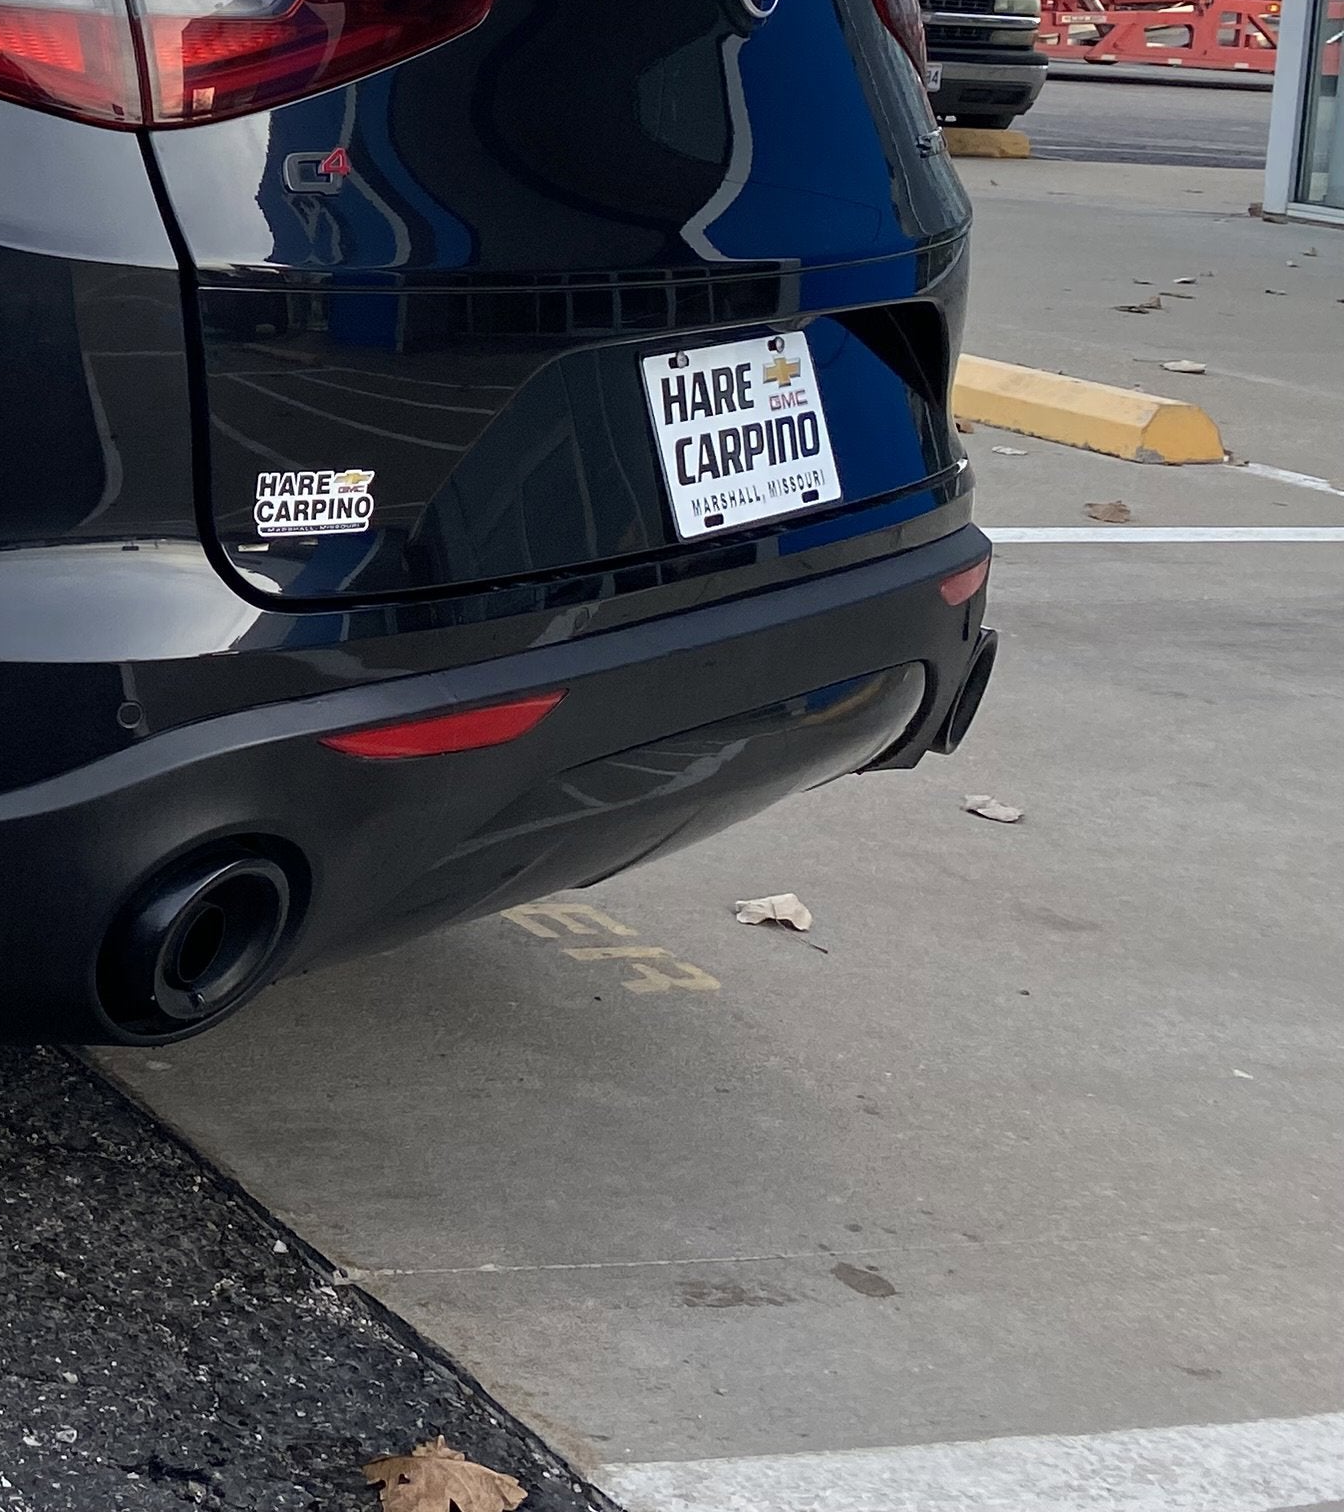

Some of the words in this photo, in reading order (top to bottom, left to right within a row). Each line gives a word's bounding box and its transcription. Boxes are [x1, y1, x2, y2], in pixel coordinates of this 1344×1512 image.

[661, 362, 754, 426] HARE
[768, 389, 808, 412] GMC
[675, 410, 821, 487] CARPINO
[258, 474, 332, 497] HARE
[767, 469, 826, 498] MISSOURI
[256, 496, 371, 523] CARPINO
